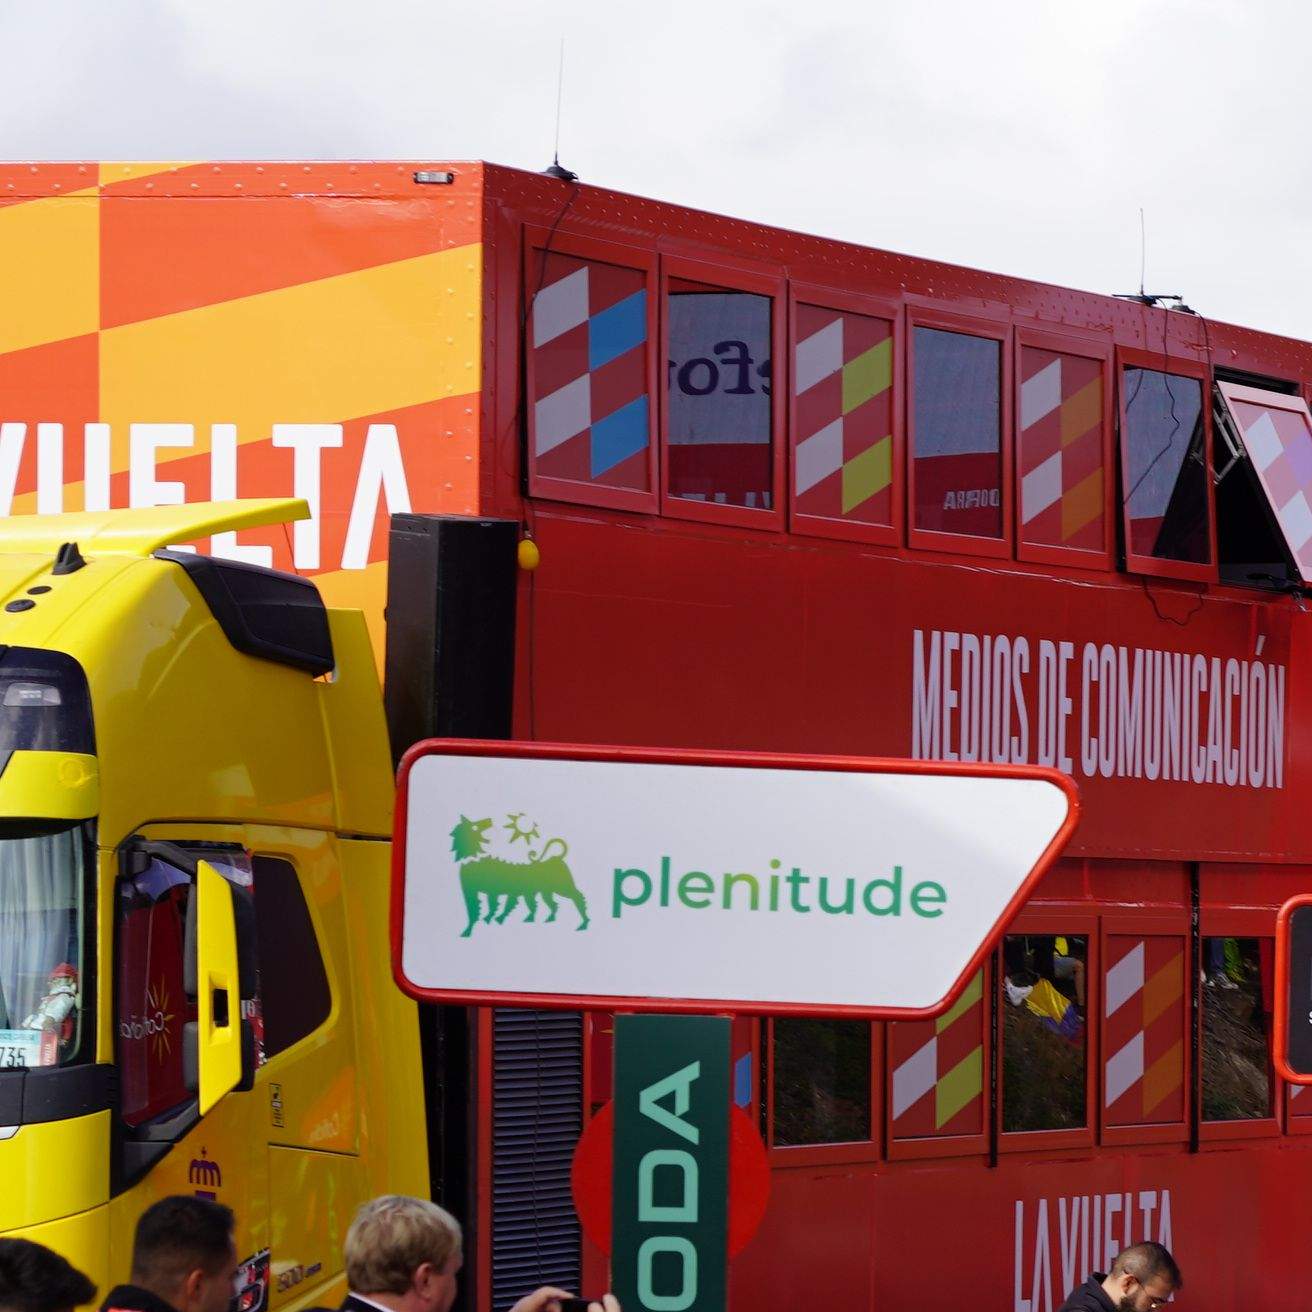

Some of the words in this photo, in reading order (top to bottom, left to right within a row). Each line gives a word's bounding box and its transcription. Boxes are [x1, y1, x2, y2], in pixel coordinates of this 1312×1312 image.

[911, 629, 1030, 764] MEDIOS
[1037, 639, 1075, 776] DE
[1080, 634, 1286, 789] COMUNICACIÓN
[611, 856, 949, 918] plenitude
